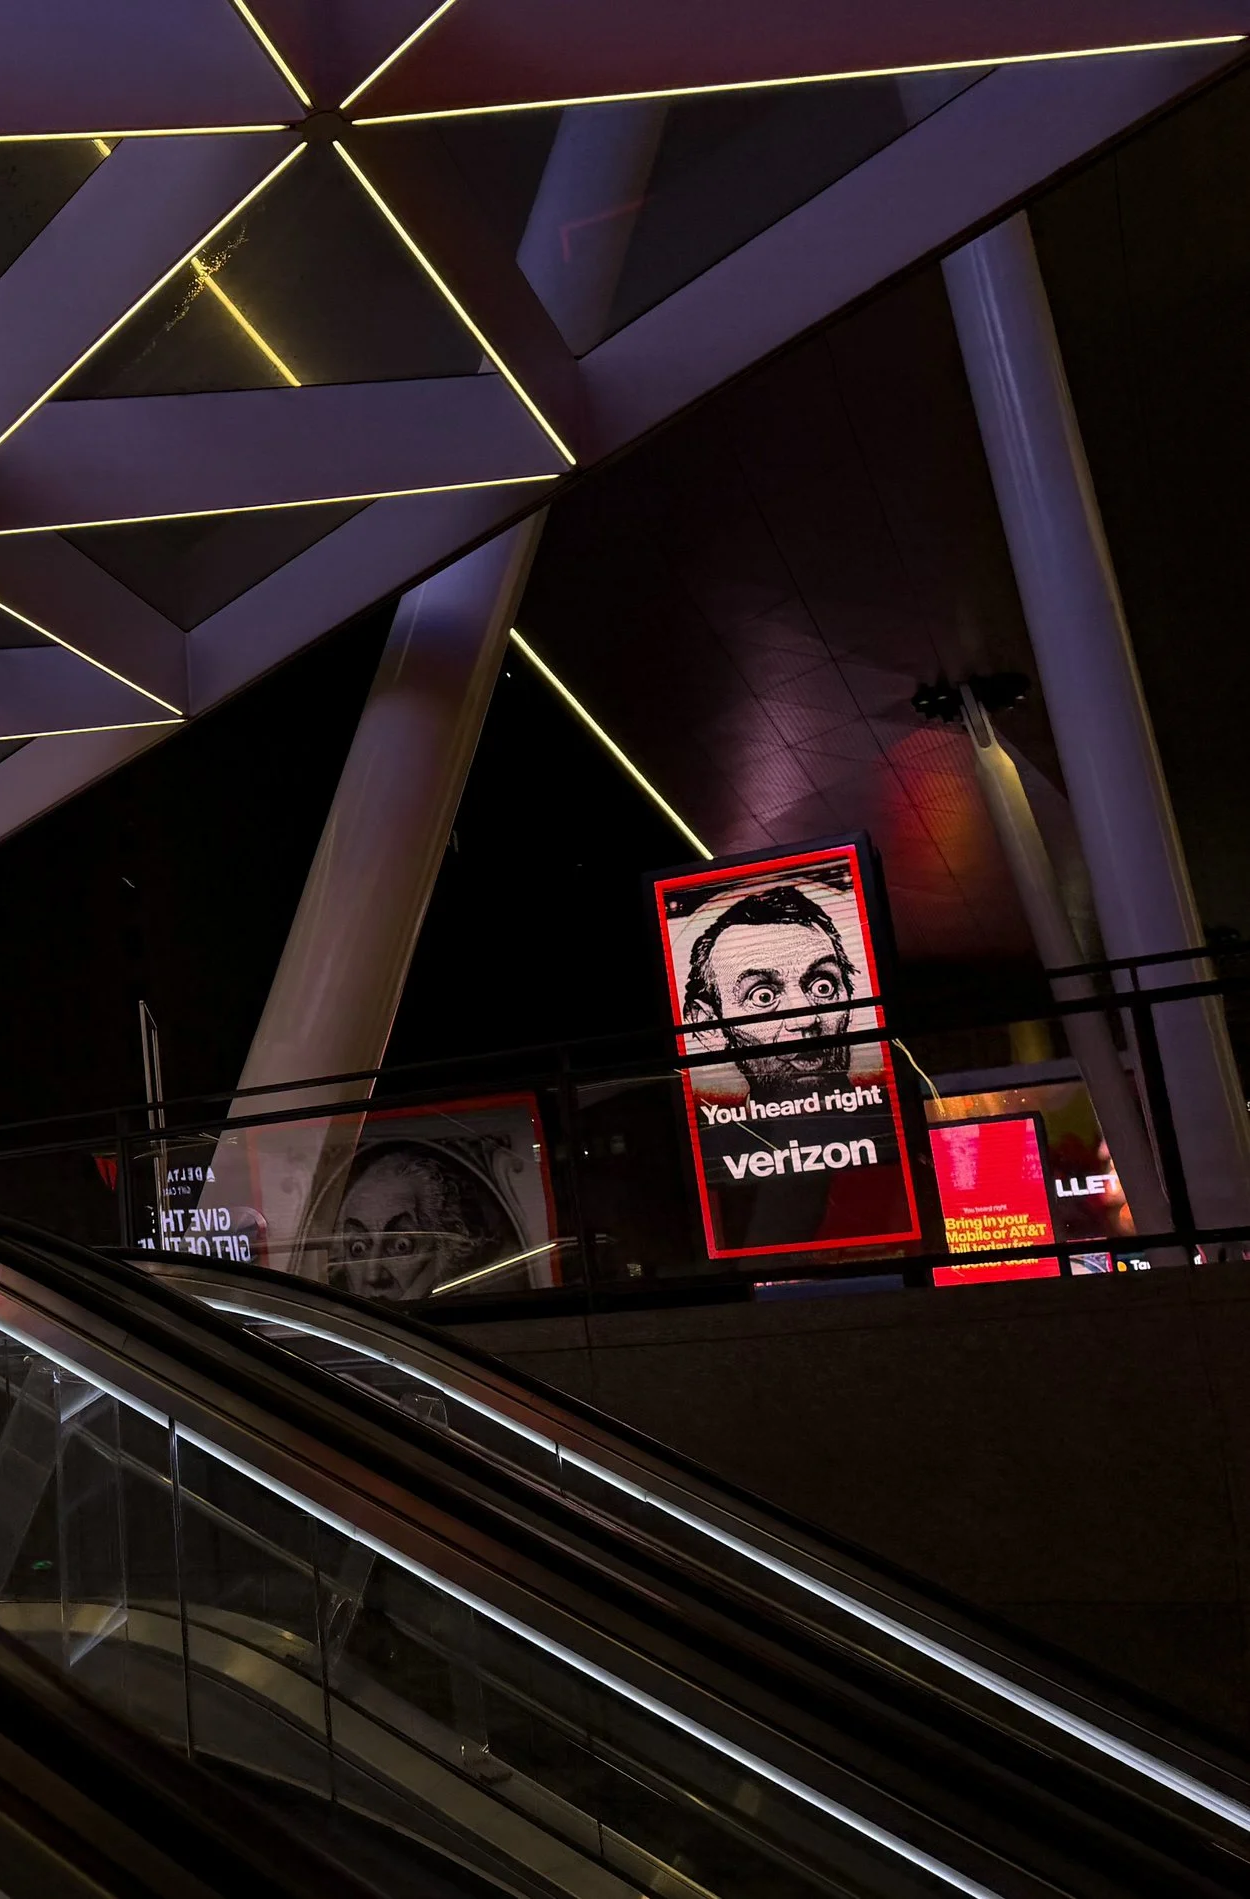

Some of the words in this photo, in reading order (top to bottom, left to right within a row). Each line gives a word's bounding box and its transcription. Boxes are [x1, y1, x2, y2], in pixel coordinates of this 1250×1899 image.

[701, 1104, 747, 1125] You
[750, 1092, 821, 1120] heard
[824, 1085, 883, 1112] right
[722, 1138, 878, 1180] verizon
[945, 1217, 983, 1231] Bring
[983, 1215, 997, 1228] in
[997, 1214, 1029, 1229] your
[946, 1229, 991, 1243] Mobile
[993, 1230, 1007, 1239] or
[1009, 1223, 1047, 1238] AT&T
